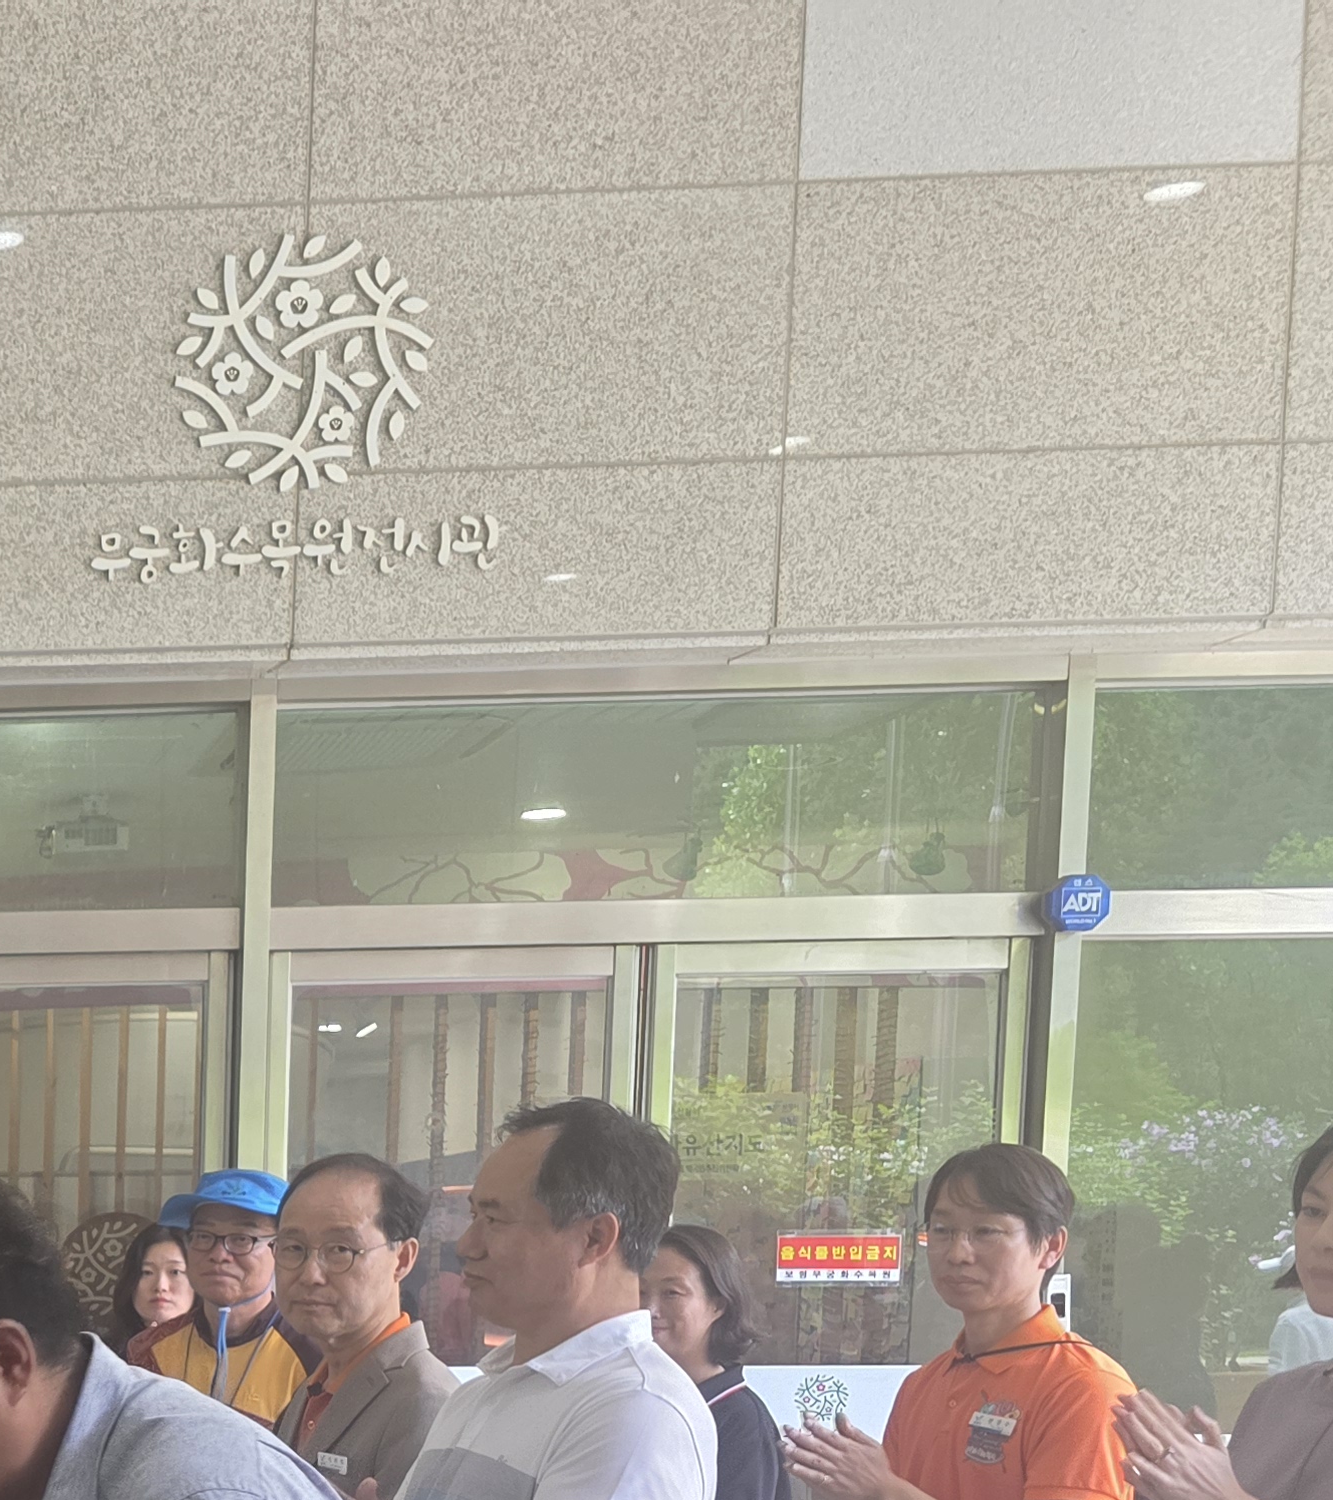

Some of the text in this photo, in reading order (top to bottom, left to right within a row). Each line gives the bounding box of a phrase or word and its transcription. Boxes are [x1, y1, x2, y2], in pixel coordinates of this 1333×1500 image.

[91, 514, 501, 584] 무궁화수목원전시관
[1062, 892, 1101, 912] ADT
[780, 1244, 898, 1261] 음식물반입금지
